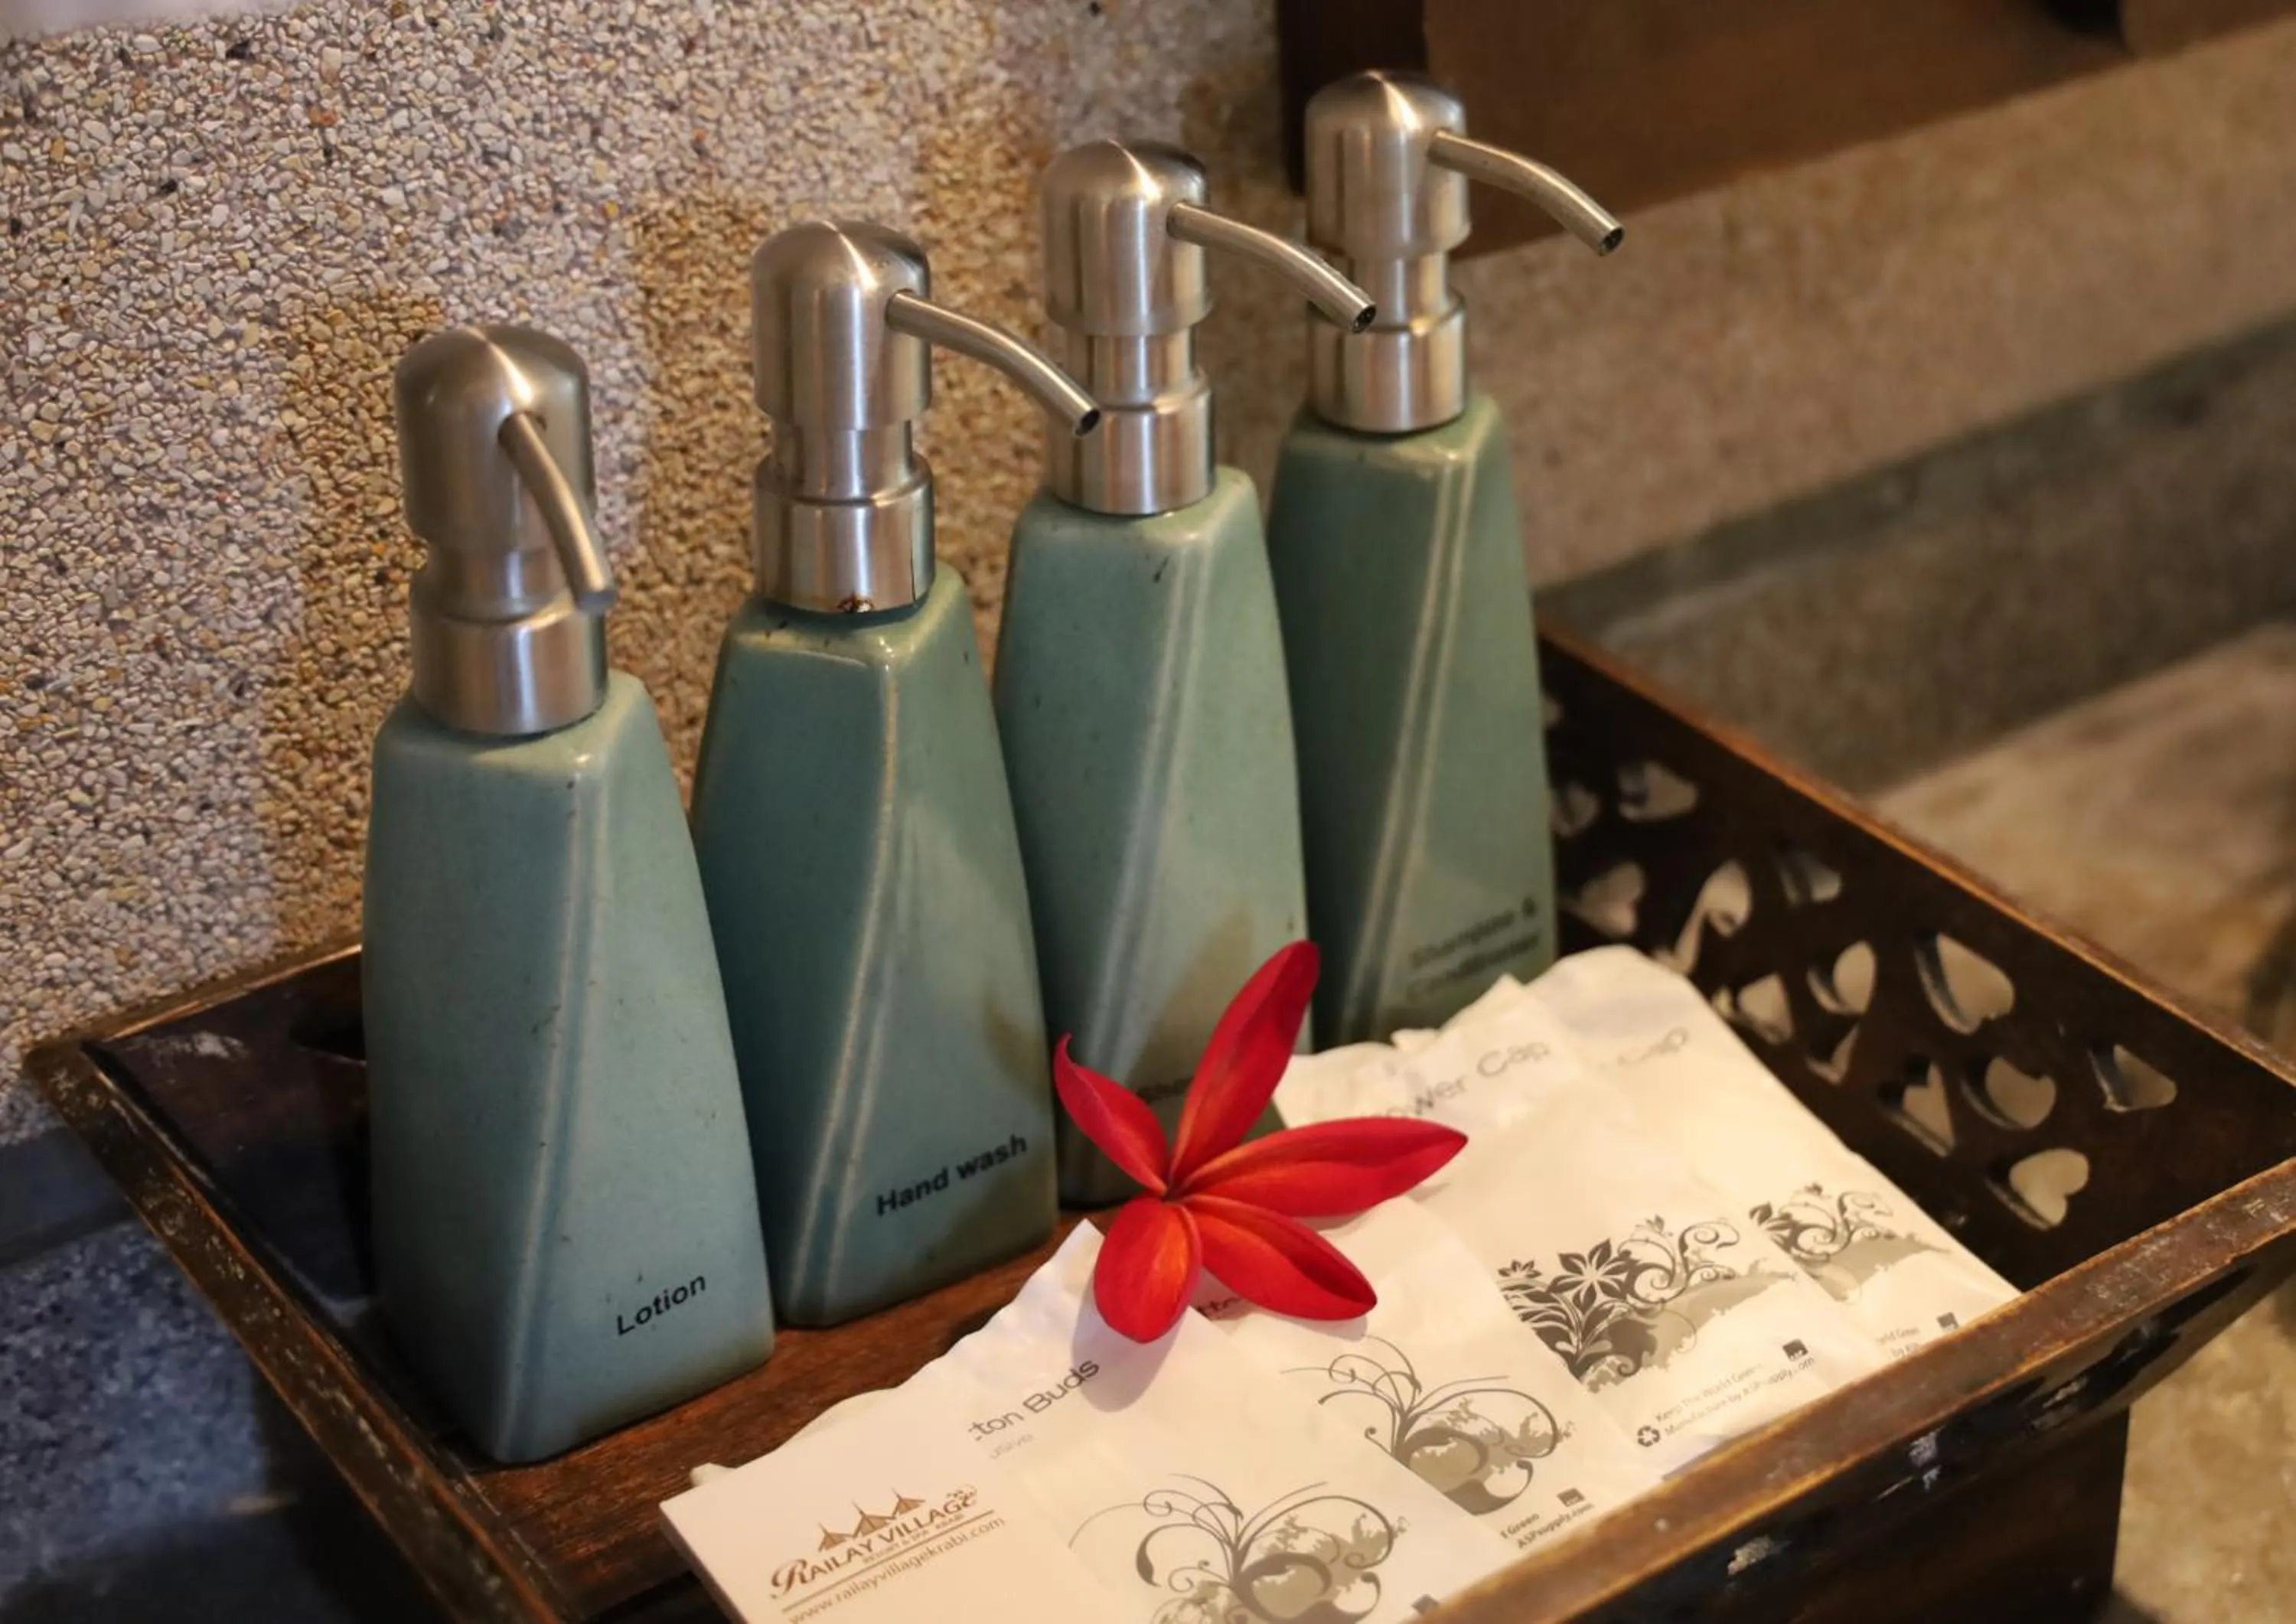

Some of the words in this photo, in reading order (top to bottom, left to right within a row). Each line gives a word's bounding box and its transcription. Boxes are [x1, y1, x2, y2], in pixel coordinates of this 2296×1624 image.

[877, 1166, 949, 1217] Hand
[956, 1133, 1027, 1180] wash
[616, 1273, 706, 1336] Lotion
[1022, 1359, 1100, 1414] Buds
[770, 1538, 873, 1600] RAILAY
